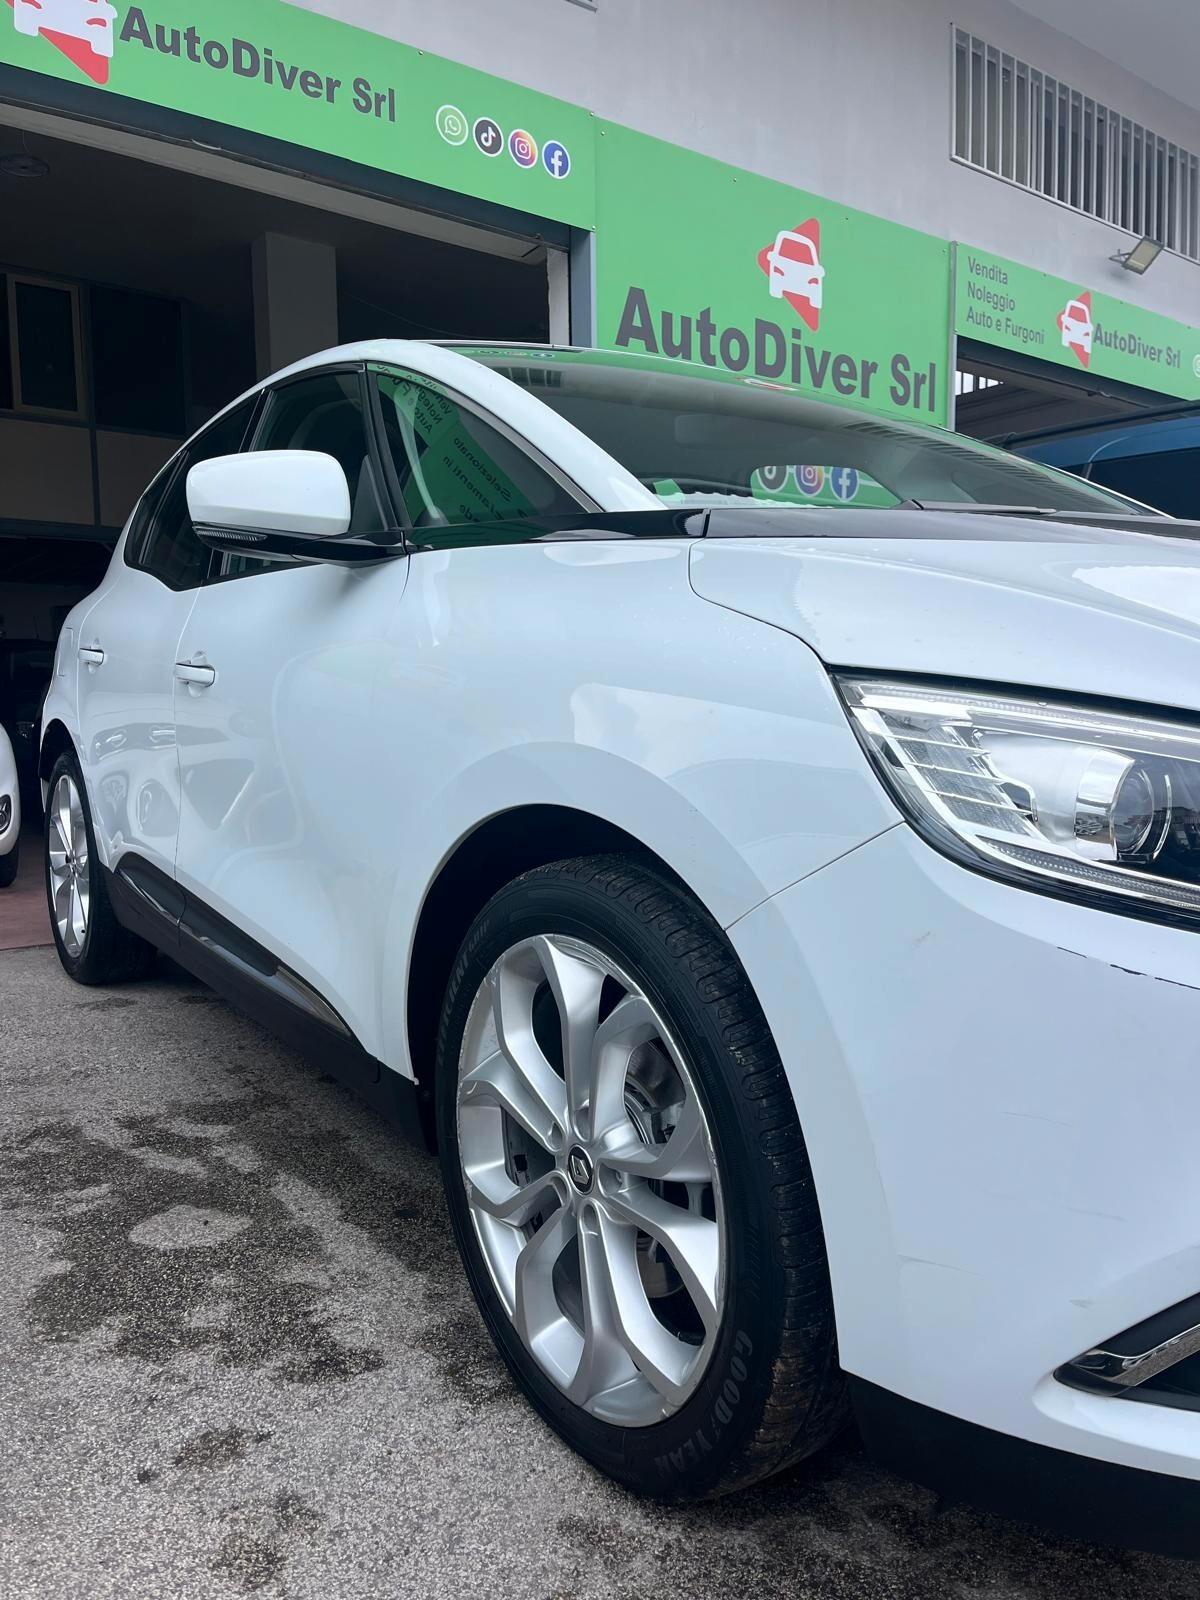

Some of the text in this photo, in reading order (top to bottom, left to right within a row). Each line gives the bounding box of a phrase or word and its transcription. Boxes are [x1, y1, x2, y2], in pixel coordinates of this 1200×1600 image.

[119, 6, 397, 122] AutoDiver Srl
[968, 256, 1008, 285] Vendita
[967, 281, 1016, 312] Noleggio
[966, 306, 1044, 344] Auto e Furgoni
[1094, 323, 1181, 369] AutoDiver Srl
[615, 286, 936, 412] AutoDiver Srl
